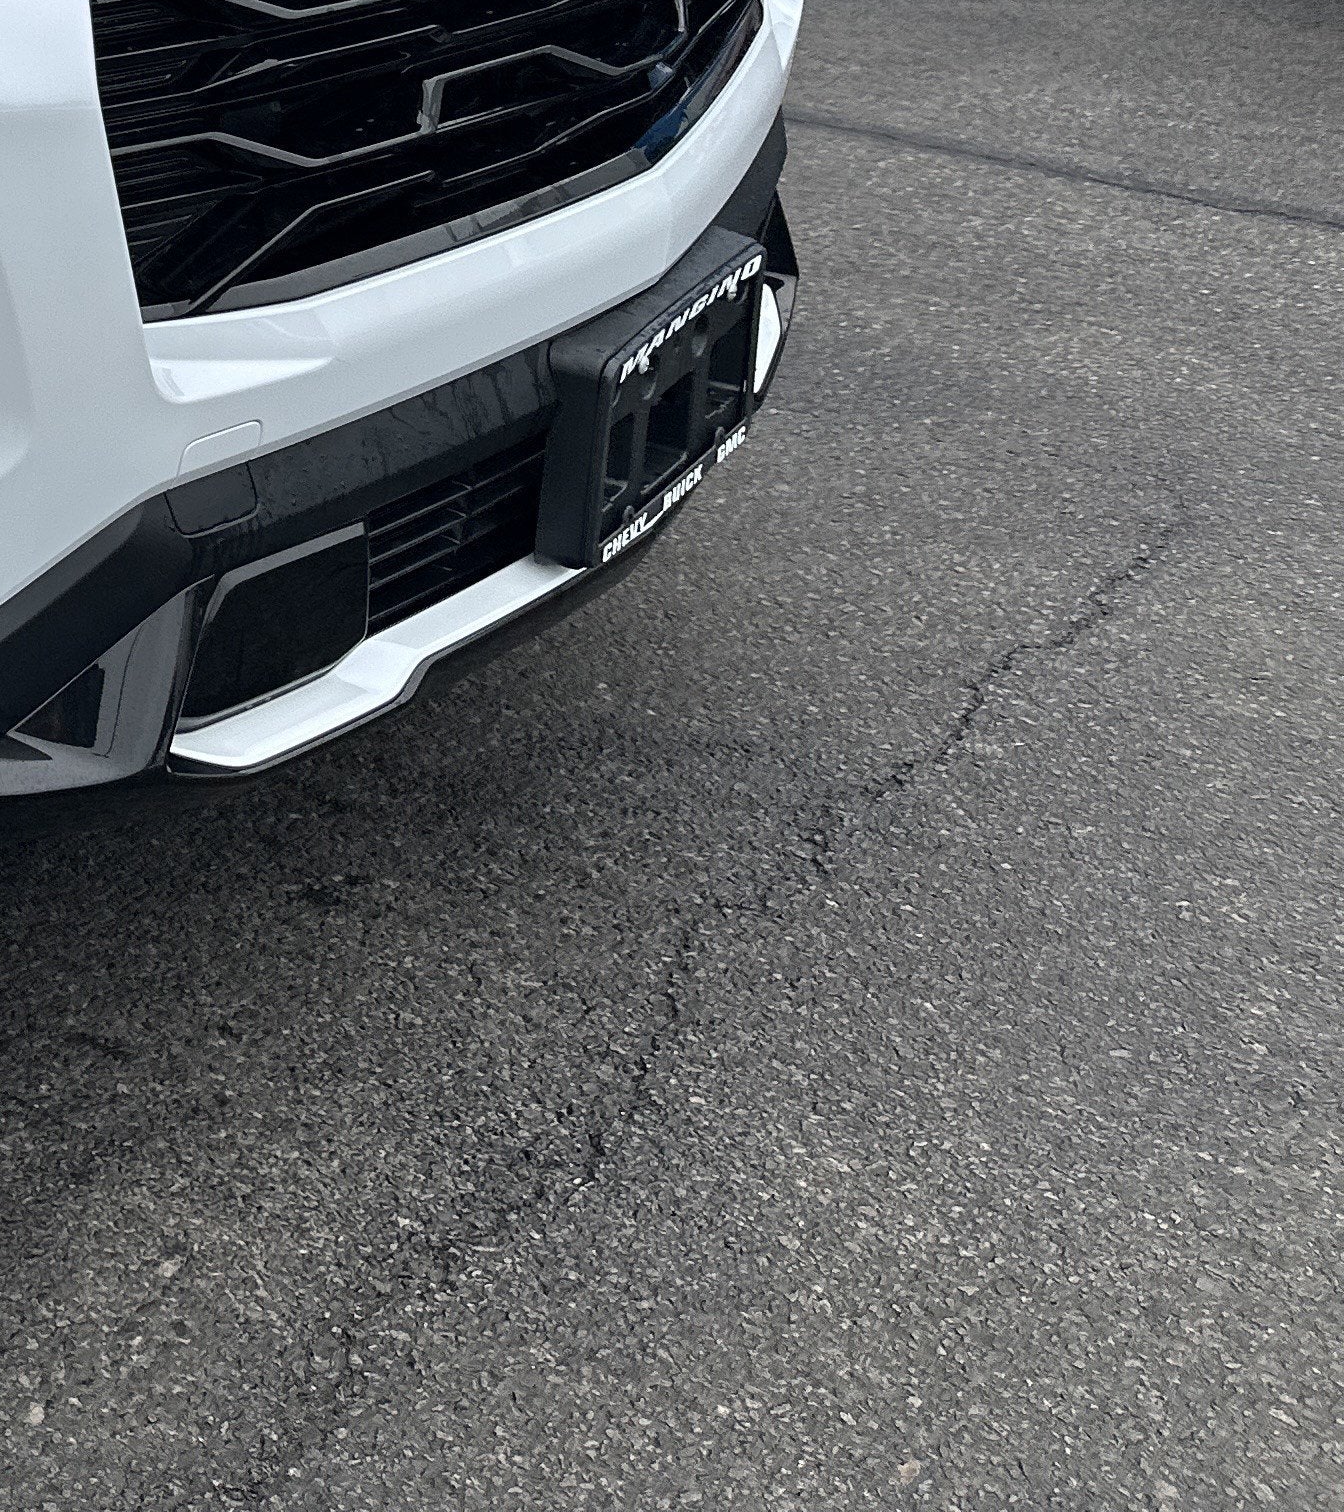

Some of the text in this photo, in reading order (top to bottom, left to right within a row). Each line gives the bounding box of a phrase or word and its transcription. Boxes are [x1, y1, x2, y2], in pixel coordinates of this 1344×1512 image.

[619, 254, 762, 384] MANGINO
[602, 426, 746, 563] CHEVY BUICK GMC
